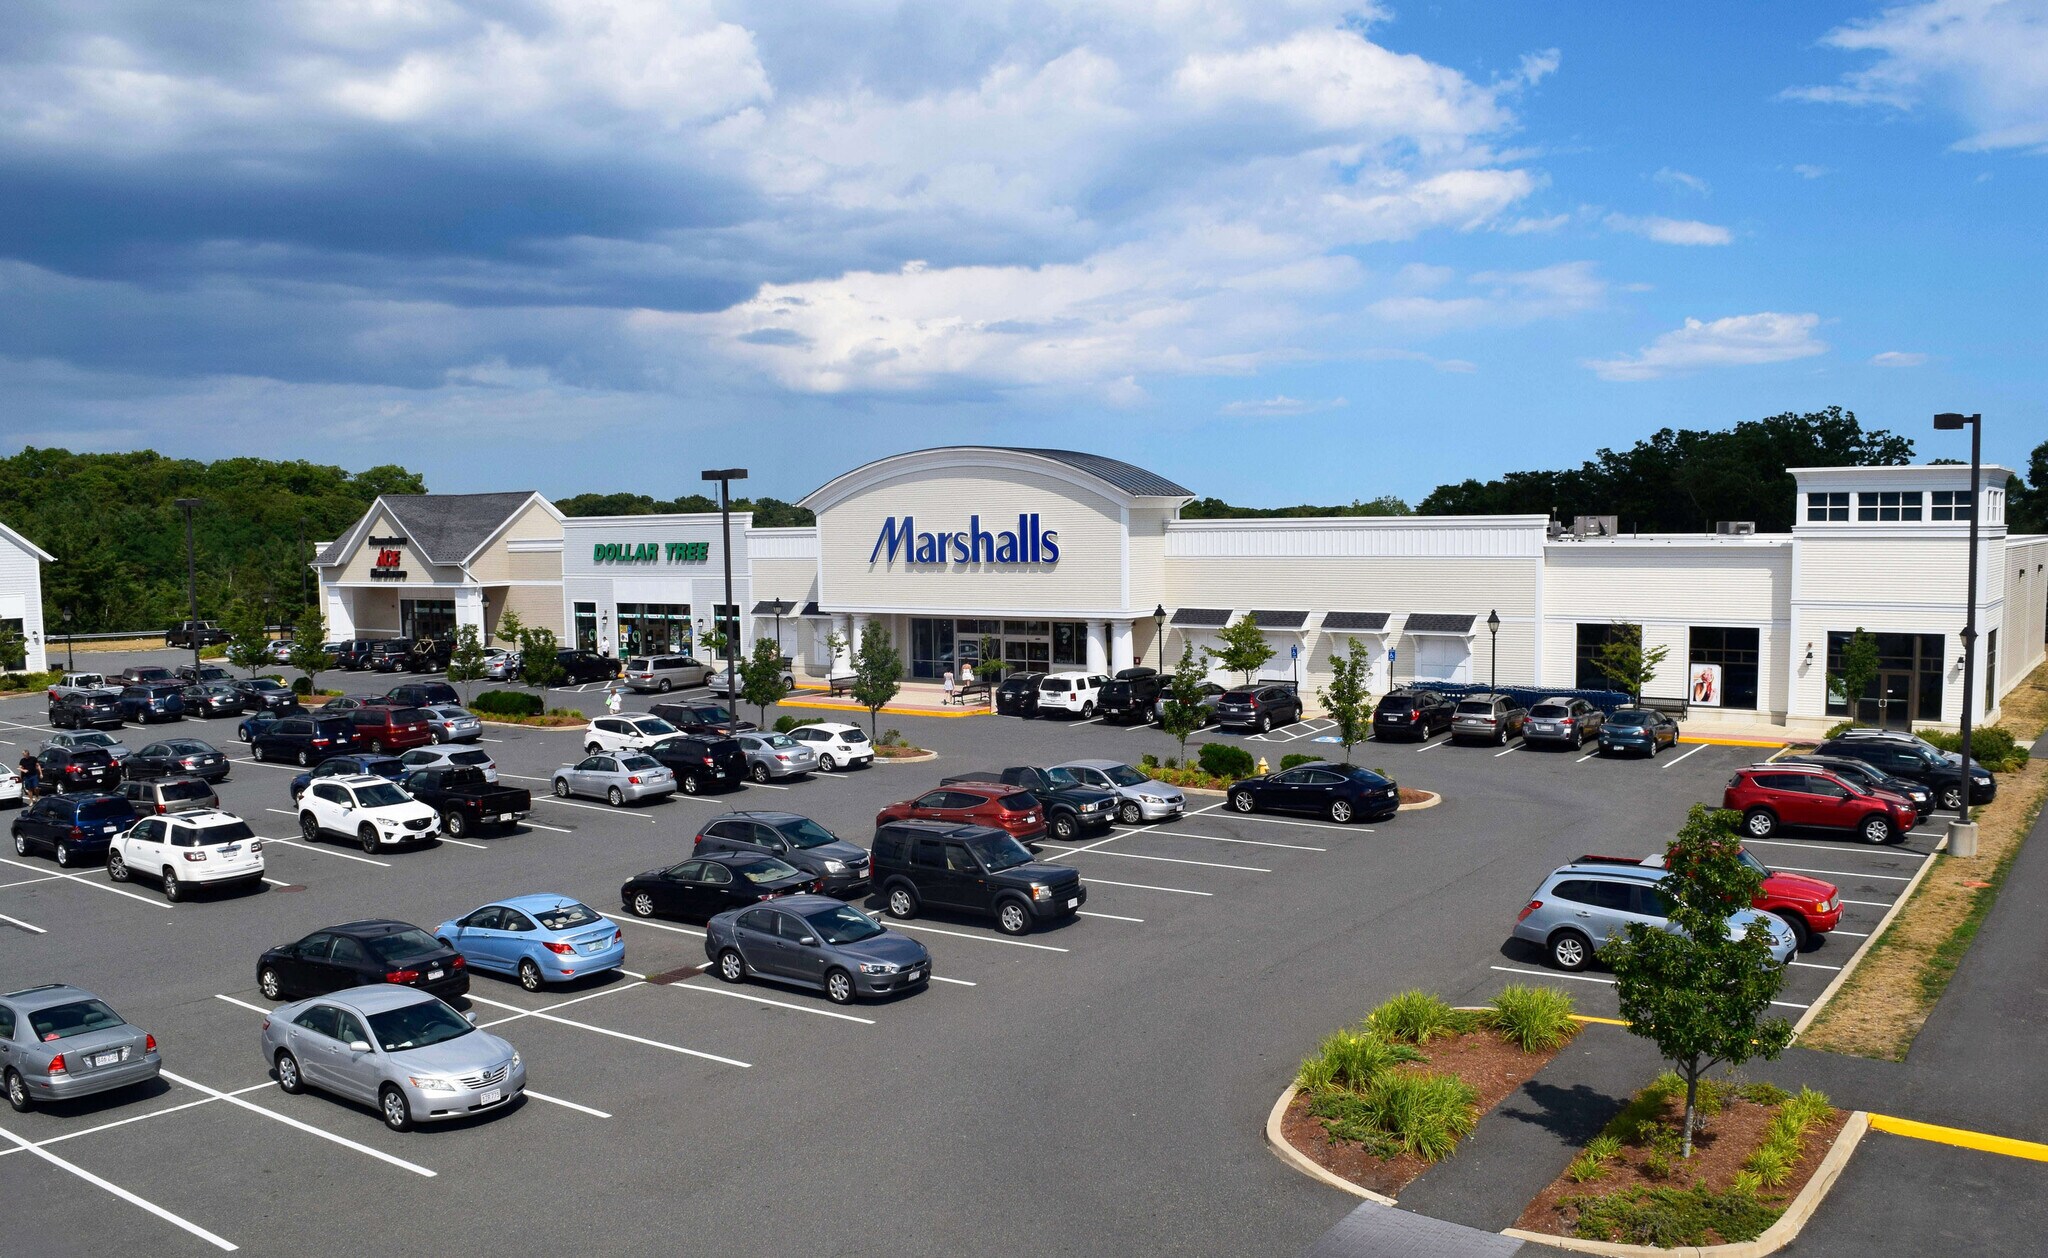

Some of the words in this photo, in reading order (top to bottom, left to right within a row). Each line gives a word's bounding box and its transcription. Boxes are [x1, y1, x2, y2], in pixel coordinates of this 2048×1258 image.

[869, 513, 1060, 564] Marshalls
[375, 546, 401, 567] ACE
[593, 543, 659, 561] DOLLAR
[665, 542, 709, 561] TREE
